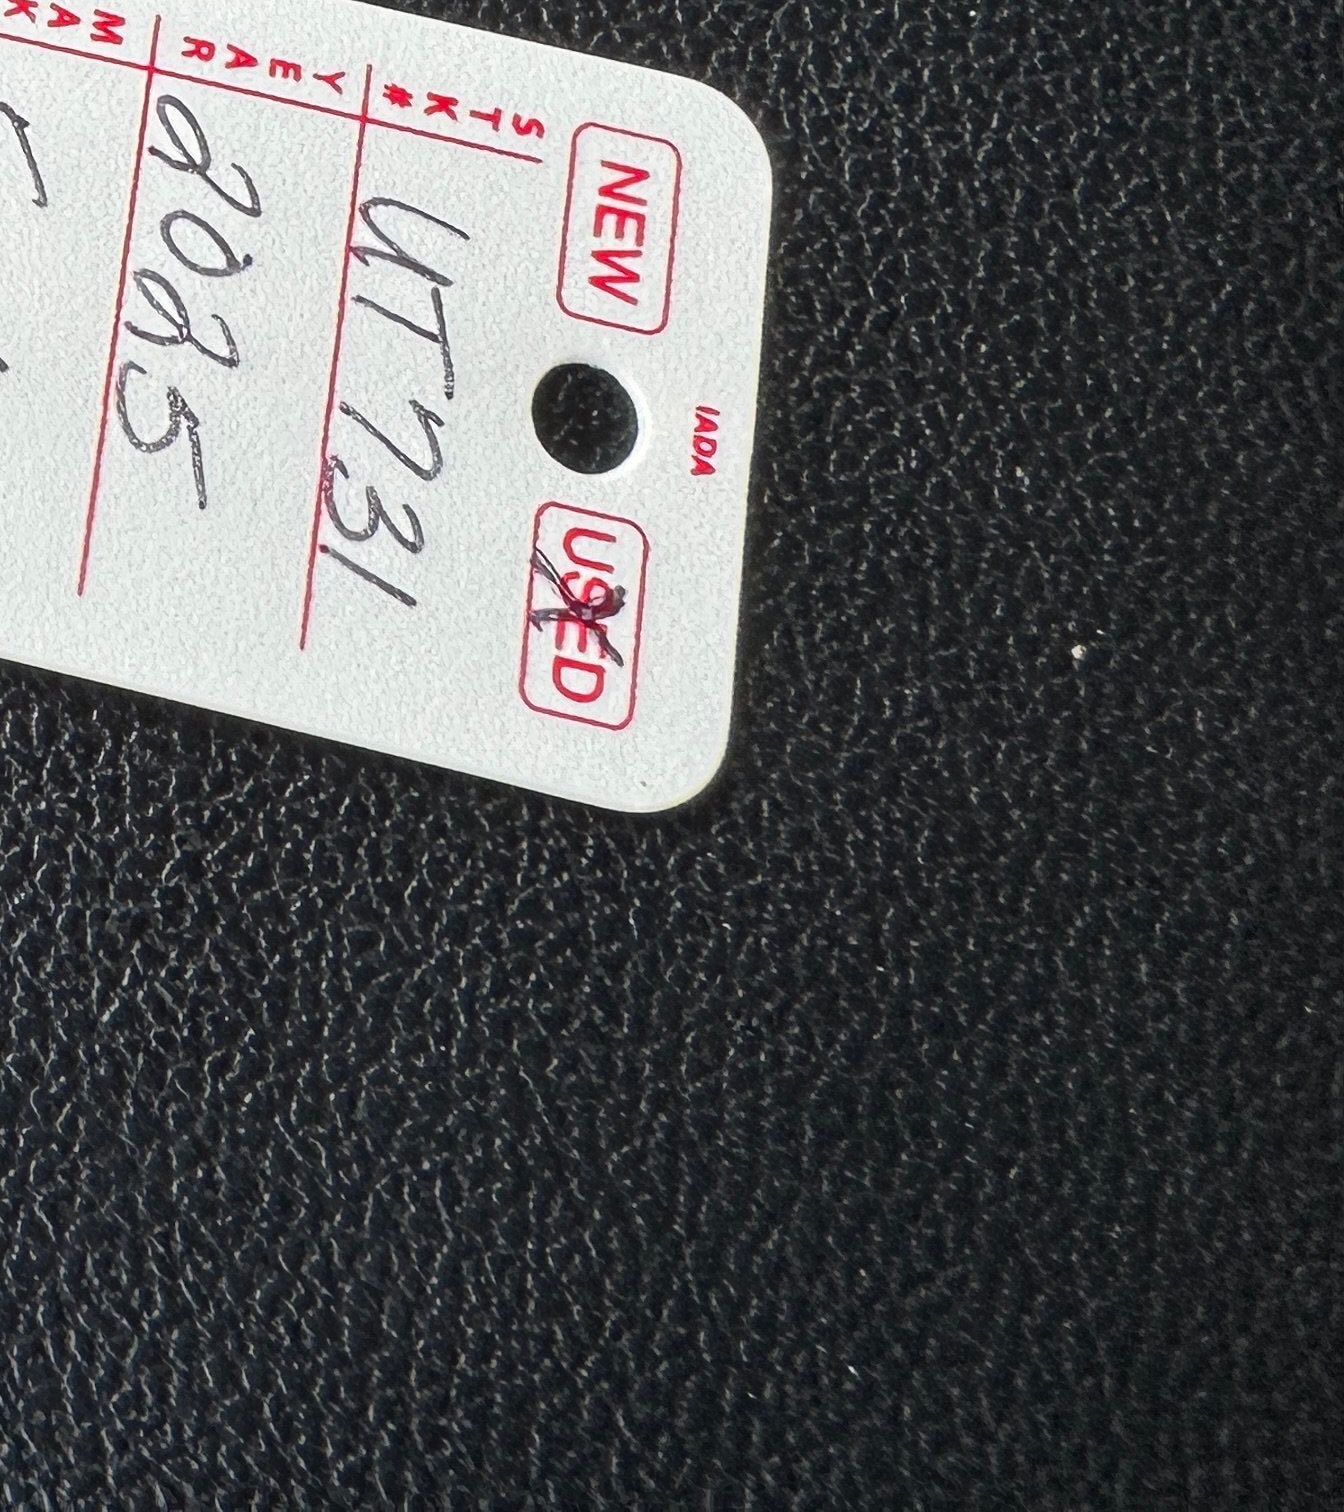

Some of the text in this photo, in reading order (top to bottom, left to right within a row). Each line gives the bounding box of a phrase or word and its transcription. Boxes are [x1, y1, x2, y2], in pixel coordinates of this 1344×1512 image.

[181, 35, 346, 94] YEAR
[383, 82, 546, 139] STK#
[589, 160, 650, 306] NEW
[115, 93, 262, 510] 2025
[691, 405, 720, 476] IADA
[551, 527, 617, 704] USED
